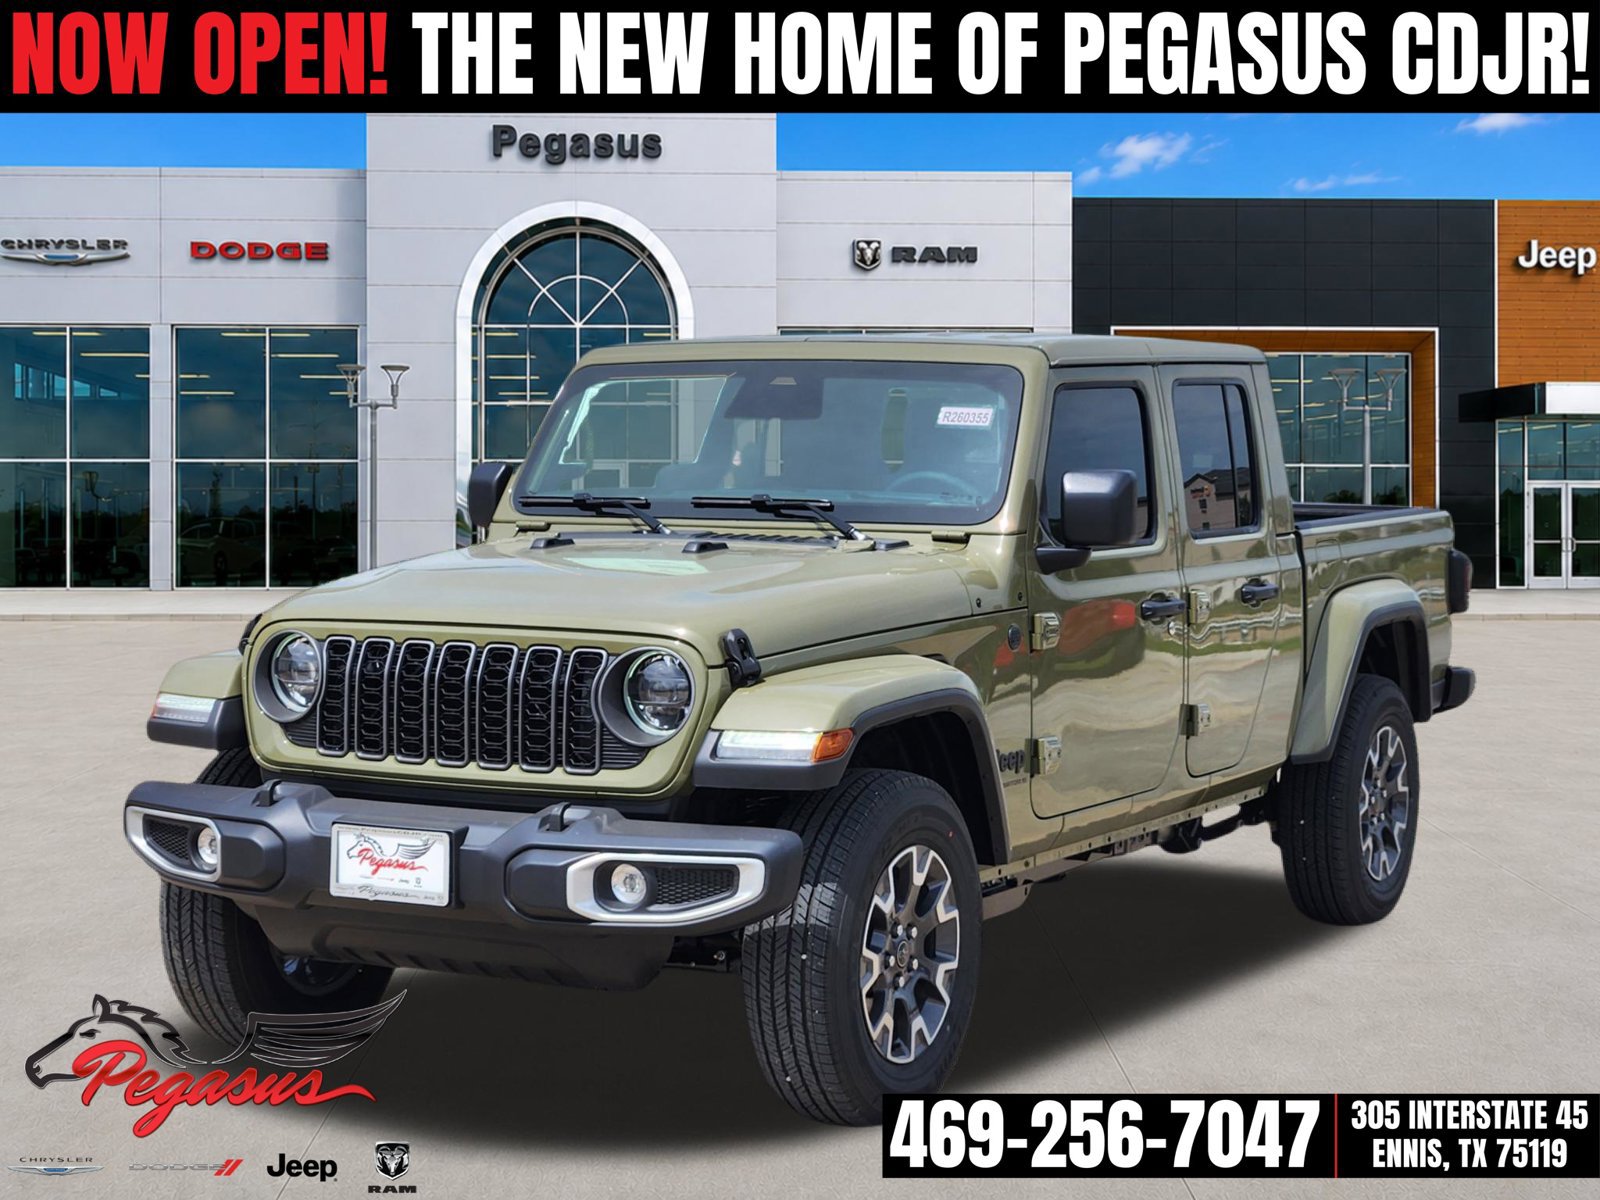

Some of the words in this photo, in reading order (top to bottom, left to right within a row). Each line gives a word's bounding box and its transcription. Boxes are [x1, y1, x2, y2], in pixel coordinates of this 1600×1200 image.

[491, 124, 662, 165] Pegasus
[0, 238, 128, 251] CHRYSLER
[190, 241, 328, 261] DODGE
[891, 245, 978, 264] RAM
[1518, 239, 1597, 275] Jeep
[942, 411, 990, 424] R260355
[357, 847, 429, 876] Pegasus
